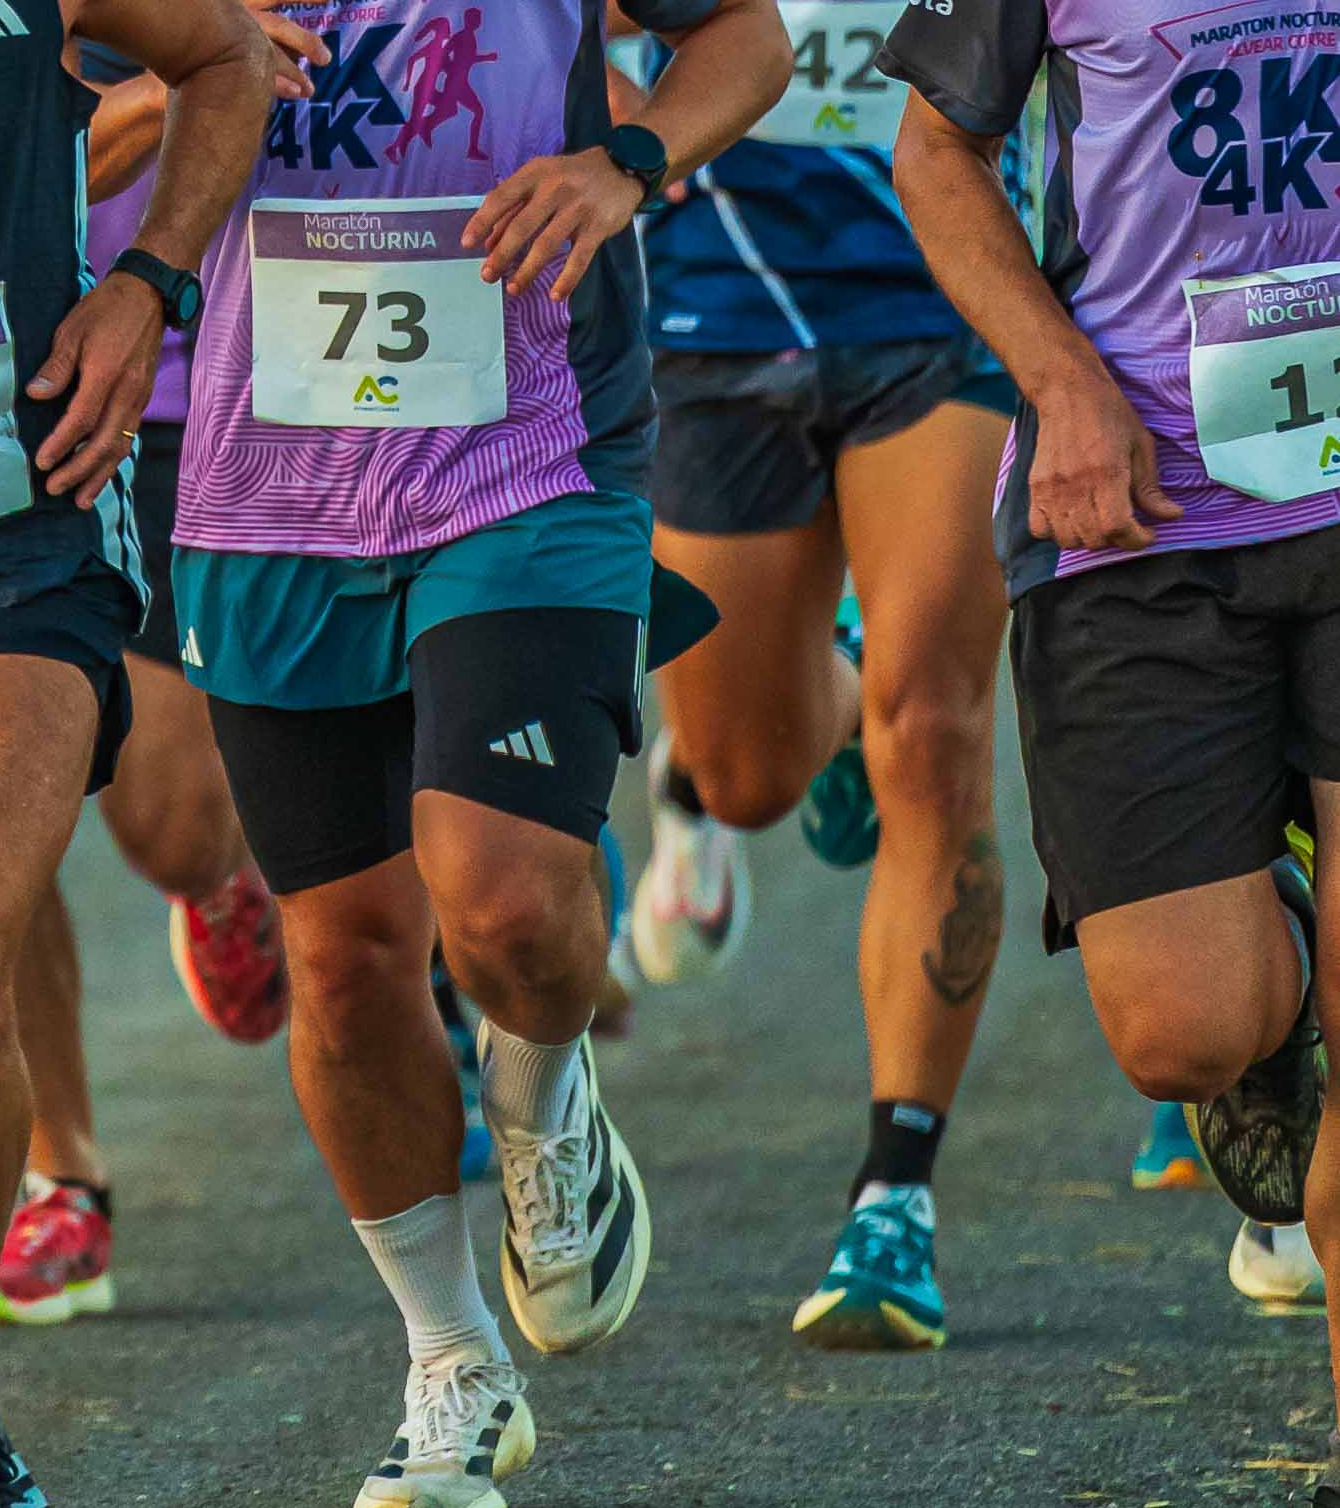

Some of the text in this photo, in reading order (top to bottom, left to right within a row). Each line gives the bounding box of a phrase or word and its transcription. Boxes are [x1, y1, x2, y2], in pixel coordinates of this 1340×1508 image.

[1190, 15, 1275, 48] MARATON
[1200, 137, 1329, 216] 4K
[304, 212, 382, 231] Maratón
[305, 231, 437, 251] NOCTURNA
[1245, 279, 1329, 305] Maratón
[318, 291, 430, 363] 73
[1246, 296, 1340, 328] NOCTU
